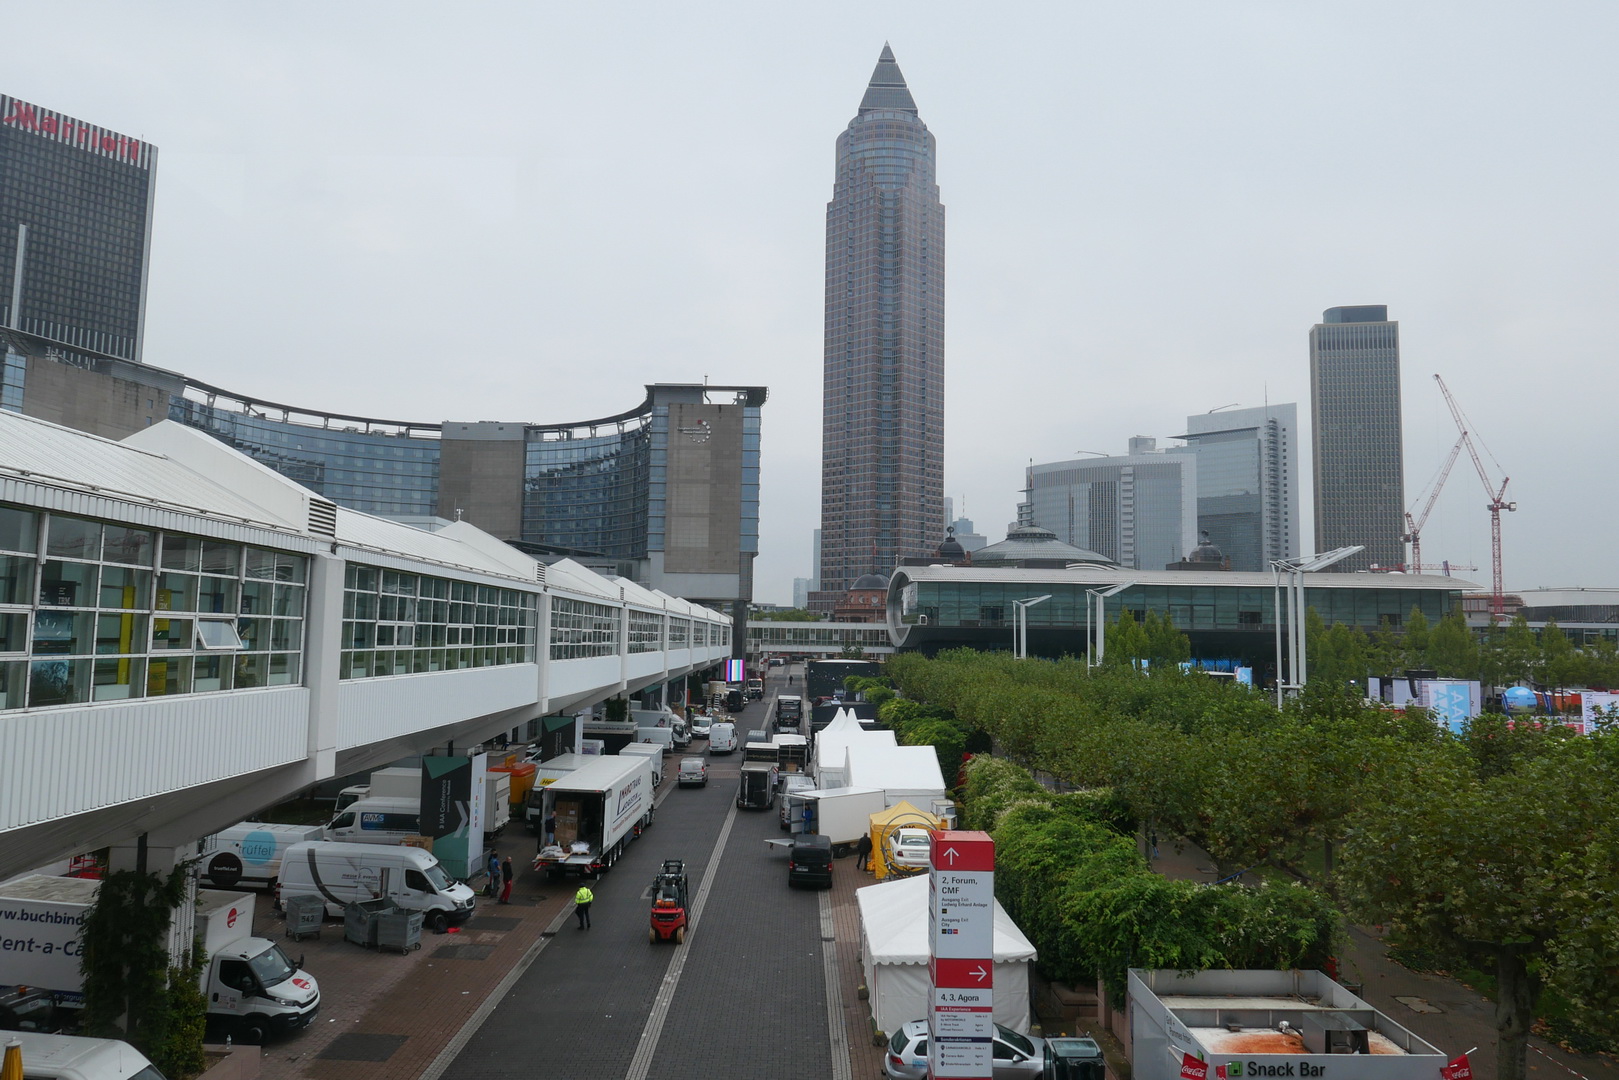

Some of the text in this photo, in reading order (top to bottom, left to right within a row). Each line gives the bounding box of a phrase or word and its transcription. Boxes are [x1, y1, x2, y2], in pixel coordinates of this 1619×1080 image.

[3, 102, 139, 160] Marriott
[58, 596, 71, 605] IBM
[238, 844, 272, 856] trüffel
[951, 877, 978, 885] Forum,
[0, 908, 85, 927] w.buchbind
[301, 915, 314, 923] 542
[0, 936, 85, 957] ent-a-Ca
[958, 994, 979, 1003] Agora
[1247, 1062, 1325, 1077] Snack Bar
